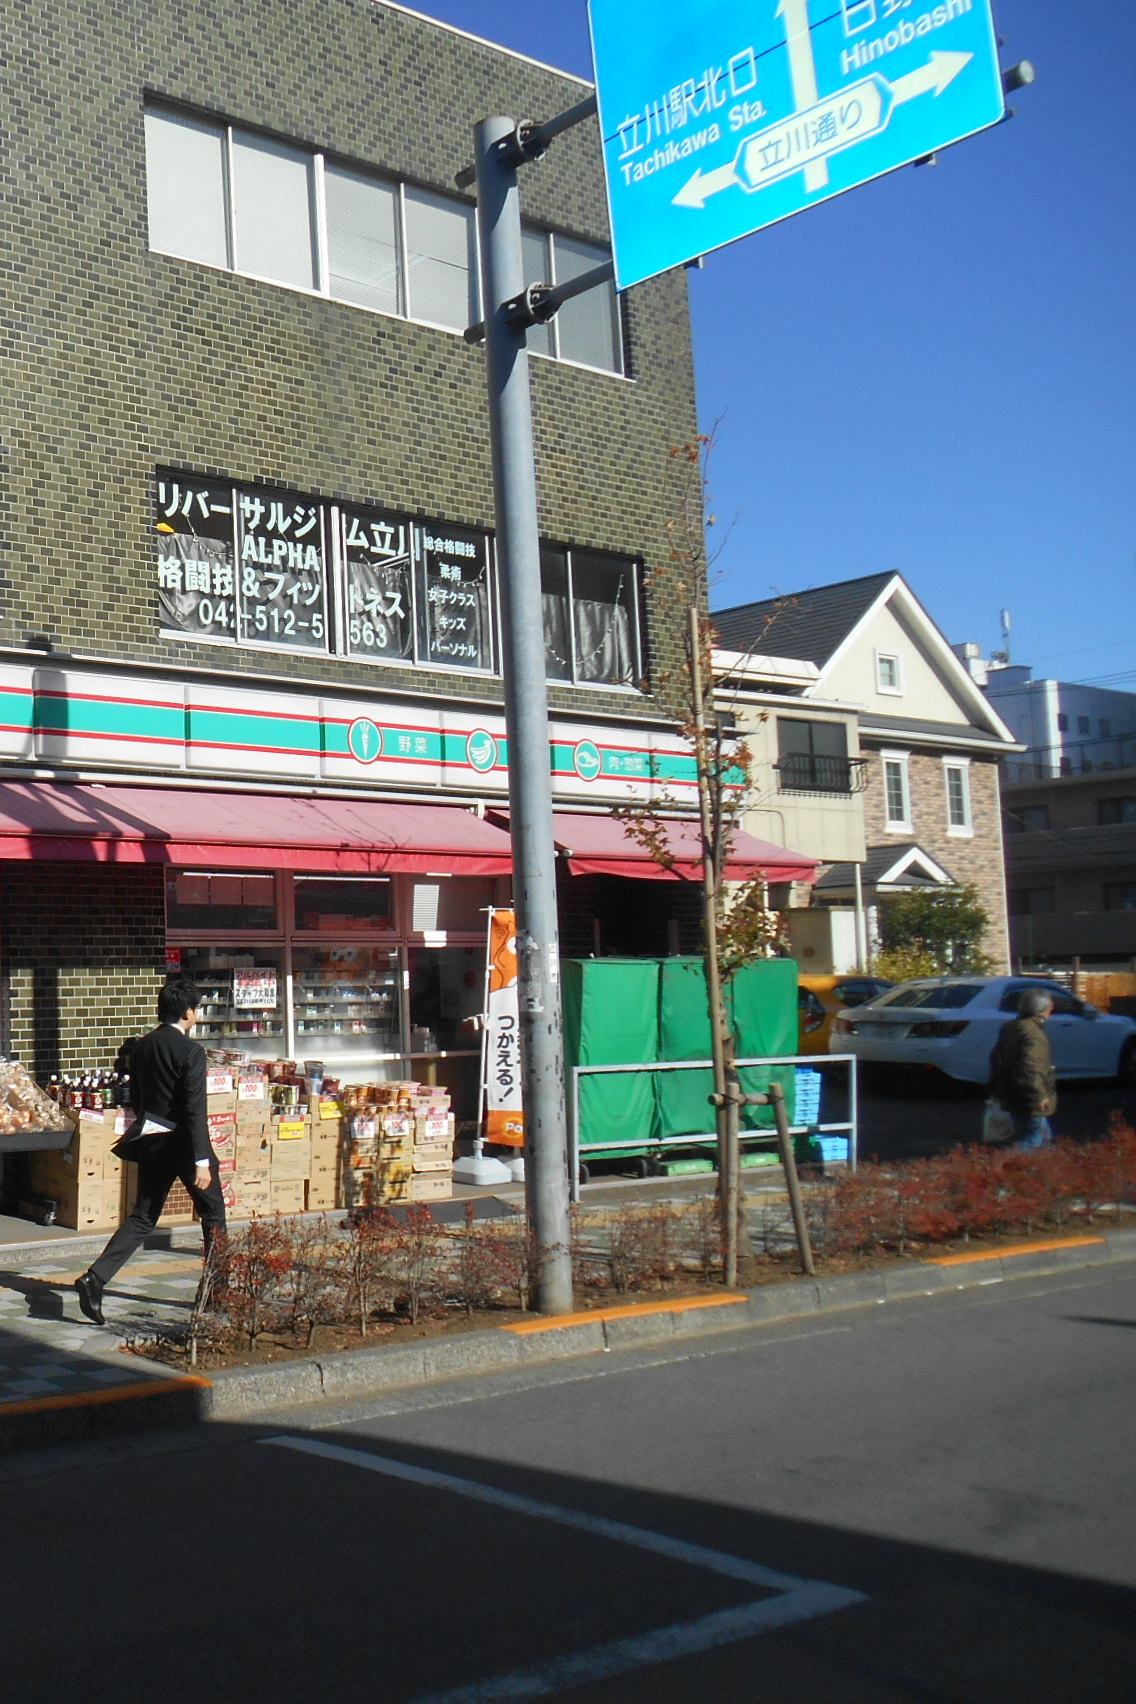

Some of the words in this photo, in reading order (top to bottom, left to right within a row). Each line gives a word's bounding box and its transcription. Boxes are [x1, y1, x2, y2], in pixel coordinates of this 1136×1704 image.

[617, 46, 758, 161] 立川駅北口
[619, 127, 721, 187] Tachikawa
[728, 98, 769, 132] Sta.
[758, 98, 864, 172] 立川通り
[241, 534, 321, 573] ALPHA
[423, 535, 476, 558] 総合格闘技
[439, 562, 462, 581] 柔術
[428, 588, 476, 607] 女子クラス
[439, 616, 466, 630] キッズ
[398, 735, 428, 754] 野菜
[235, 970, 277, 980] アルバイト
[496, 1015, 515, 1103] つかえる!
